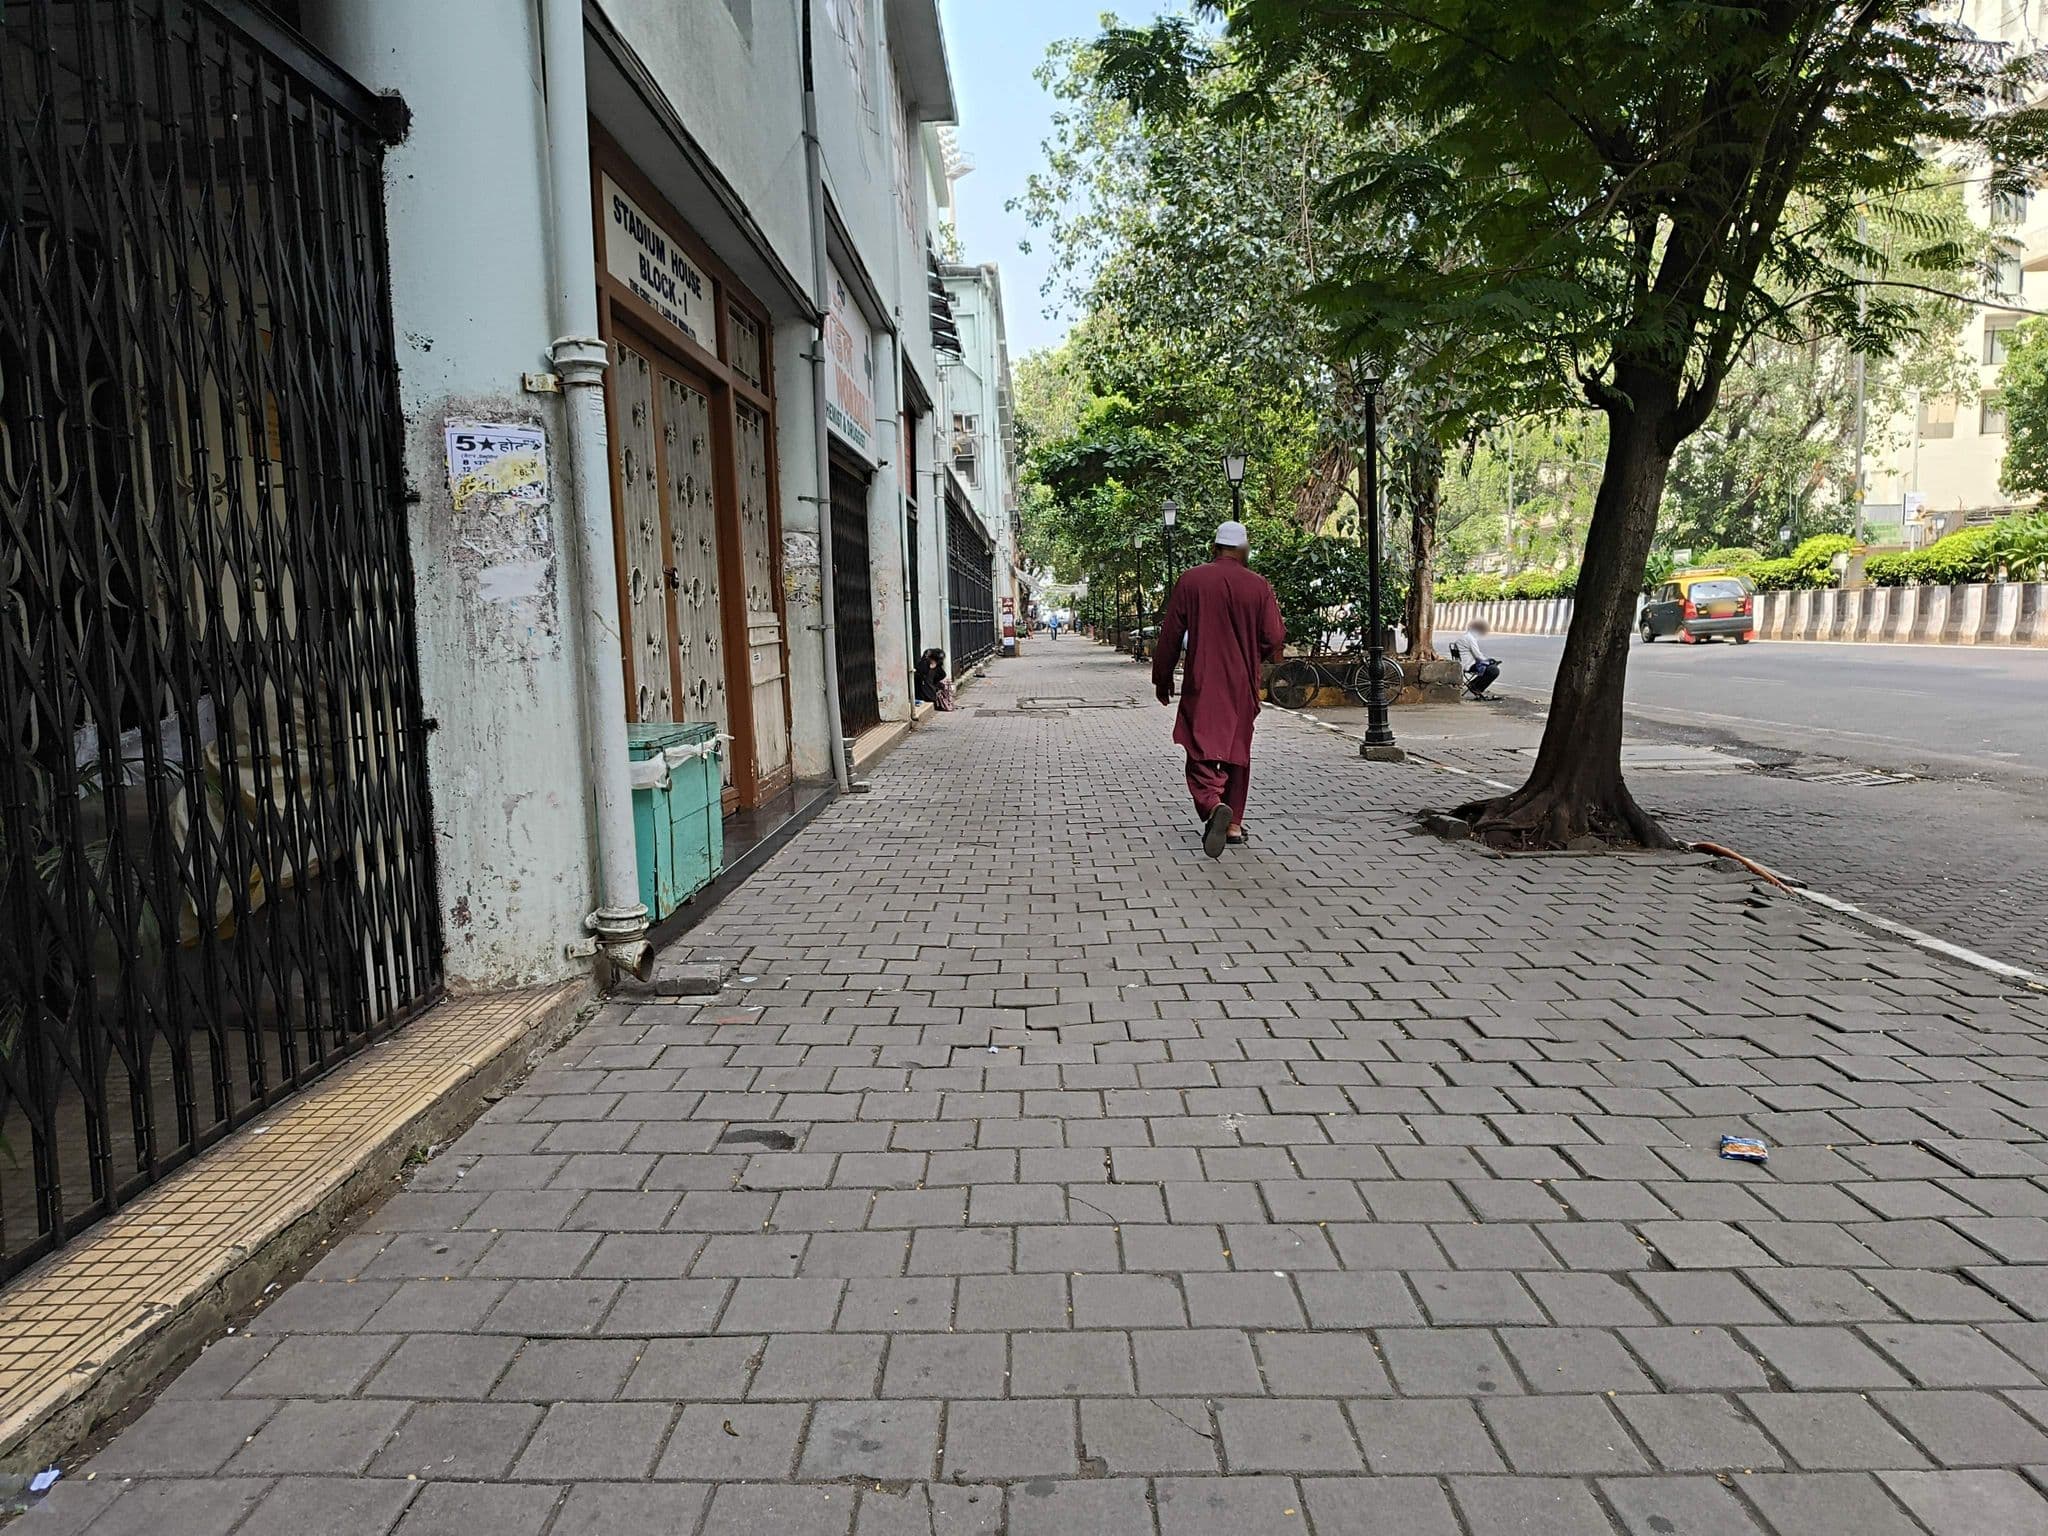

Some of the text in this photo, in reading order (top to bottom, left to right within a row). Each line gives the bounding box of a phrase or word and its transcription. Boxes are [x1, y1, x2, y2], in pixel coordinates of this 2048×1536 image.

[613, 194, 702, 301] STADIUM HOUSE
[826, 400, 842, 428] HEMIST
[455, 435, 477, 451] 5
